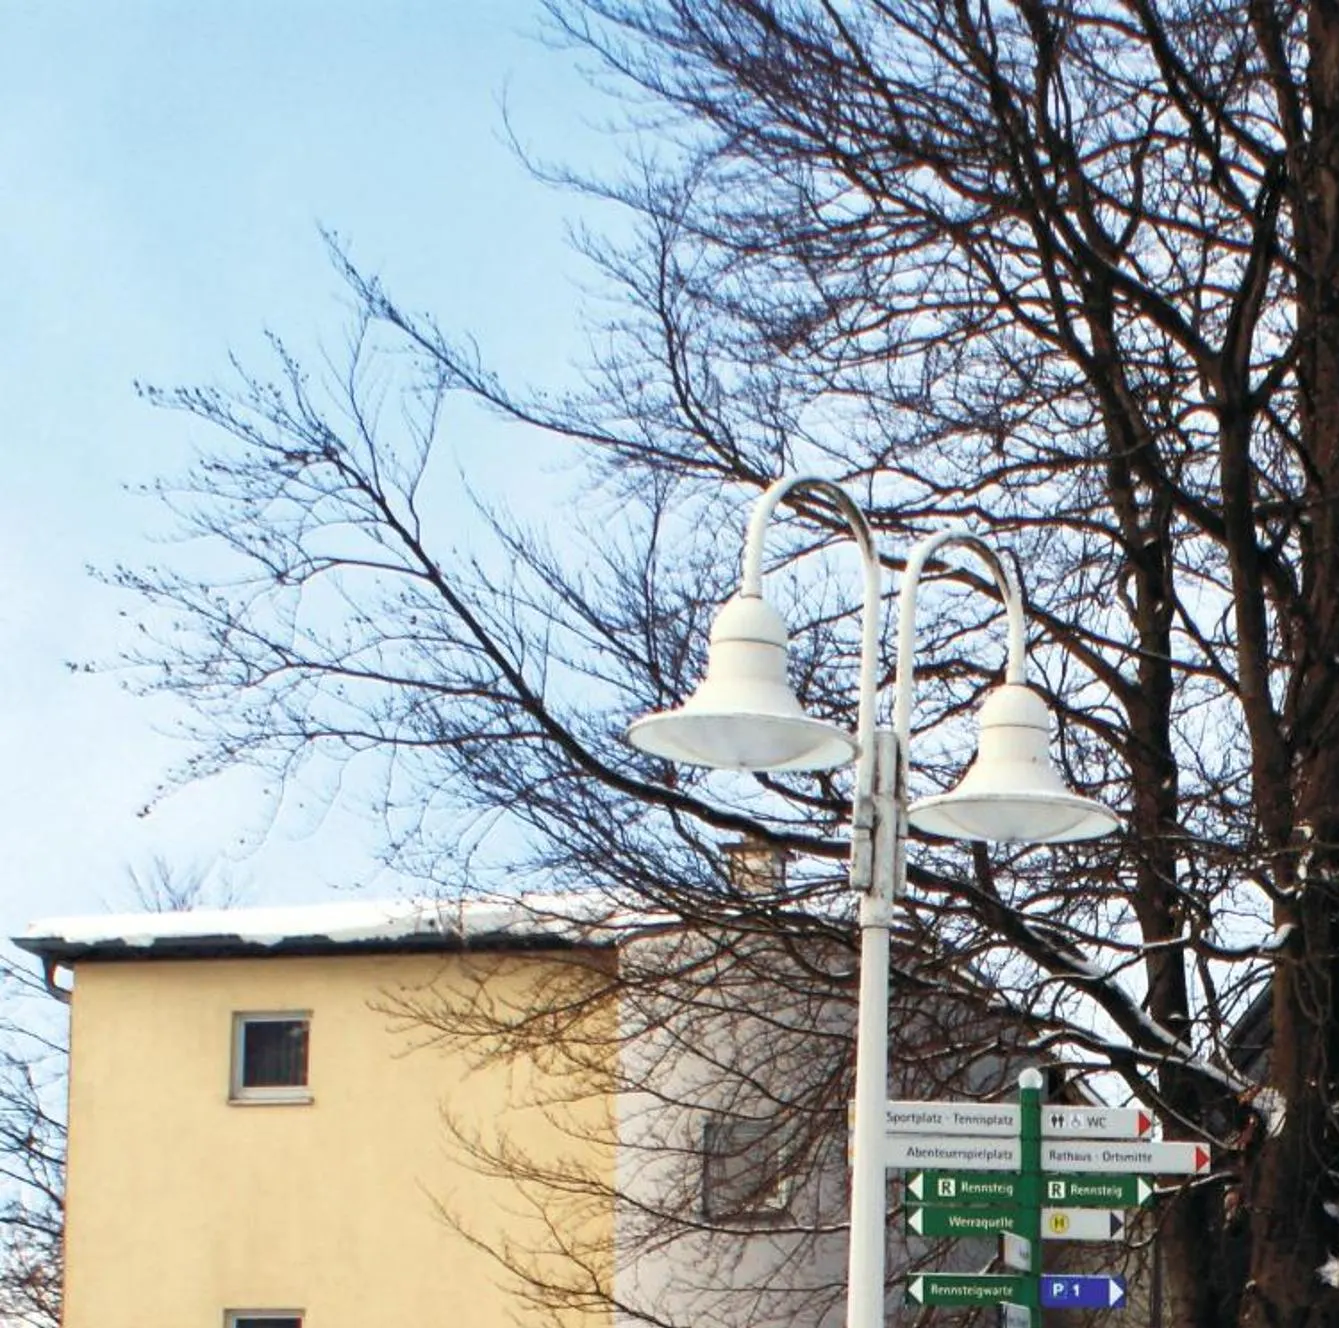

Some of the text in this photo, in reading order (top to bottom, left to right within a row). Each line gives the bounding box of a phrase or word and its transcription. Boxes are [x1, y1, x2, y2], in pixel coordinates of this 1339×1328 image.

[886, 1111, 1014, 1127] Sportplatz Tennisplatz
[1087, 1117, 1107, 1128] WC
[906, 1146, 1013, 1163] Abenteuerspielplatz
[1048, 1150, 1153, 1163] Rathaus Ortsmitte
[961, 1181, 1014, 1197] Rennsteig
[1070, 1184, 1123, 1198] Rennsteig
[948, 1216, 1015, 1229] Werraquelle
[930, 1284, 1014, 1298] Rennsteigwarte
[1052, 1283, 1080, 1297] P 1
